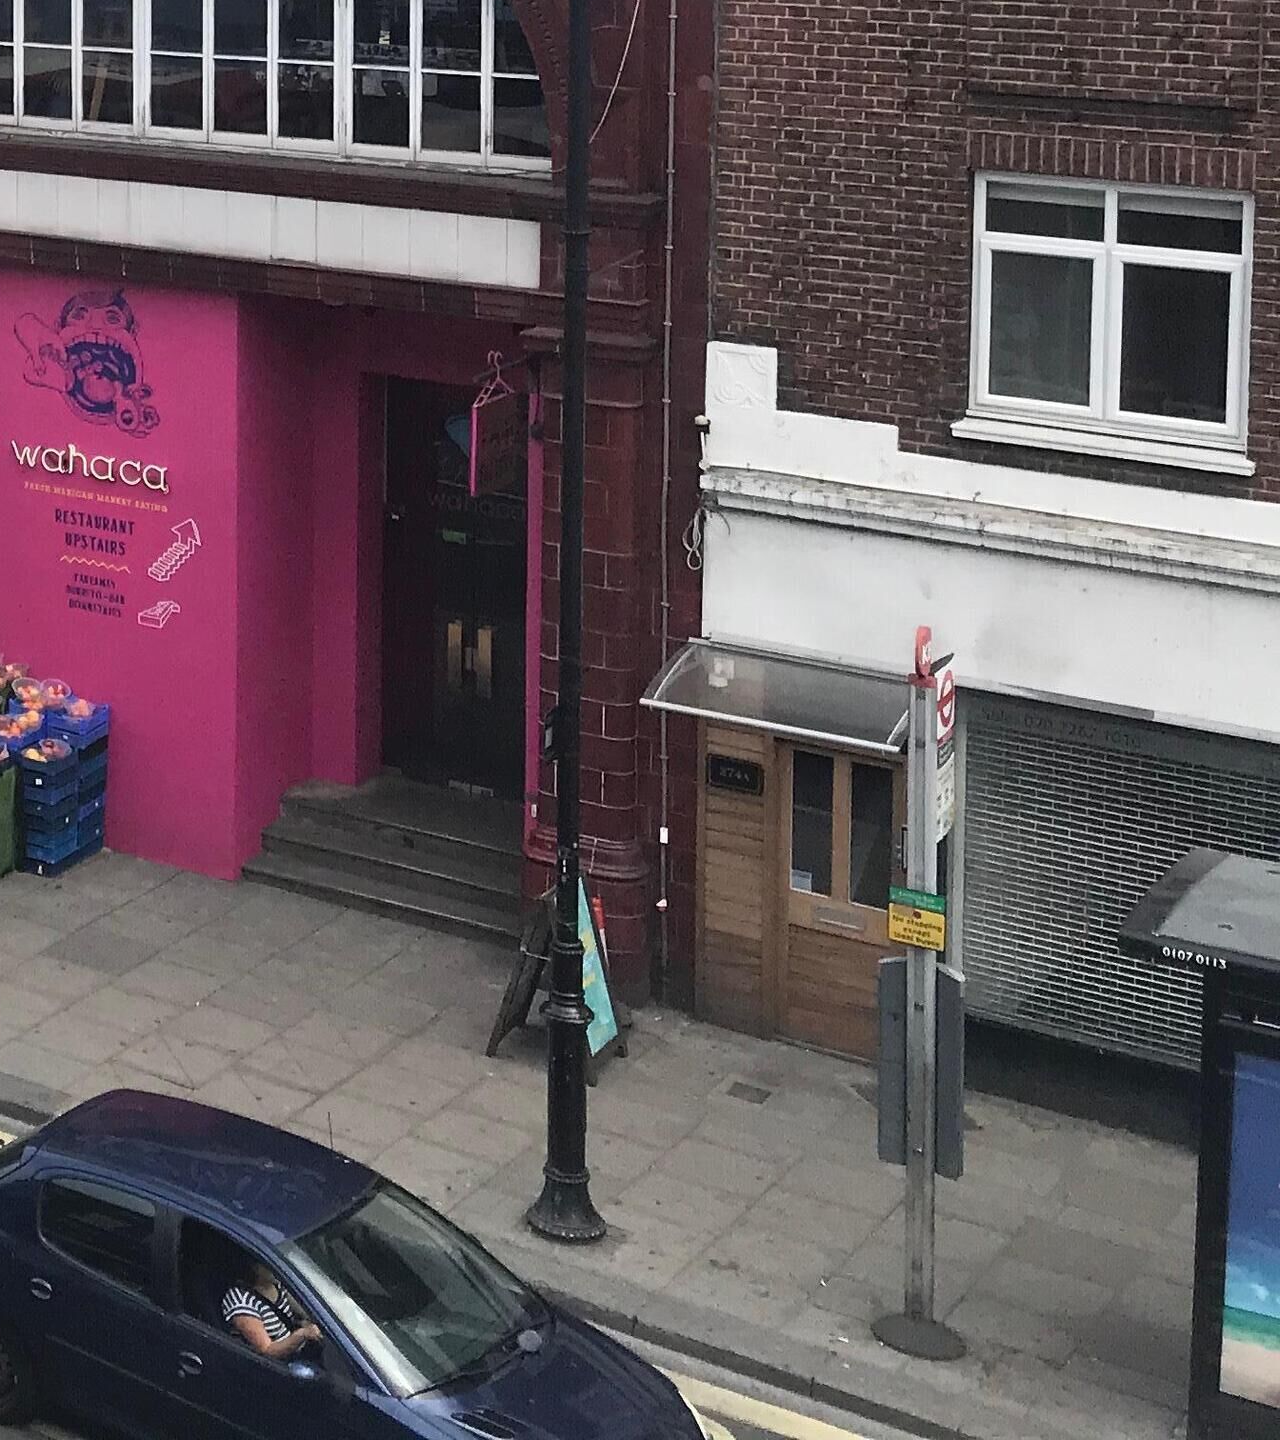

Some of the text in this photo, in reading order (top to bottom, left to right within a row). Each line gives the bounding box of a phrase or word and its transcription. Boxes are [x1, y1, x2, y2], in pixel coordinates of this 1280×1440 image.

[10, 439, 171, 494] wahaca
[54, 508, 136, 536] RESTAURANT
[64, 532, 127, 556] UPSTAIRS
